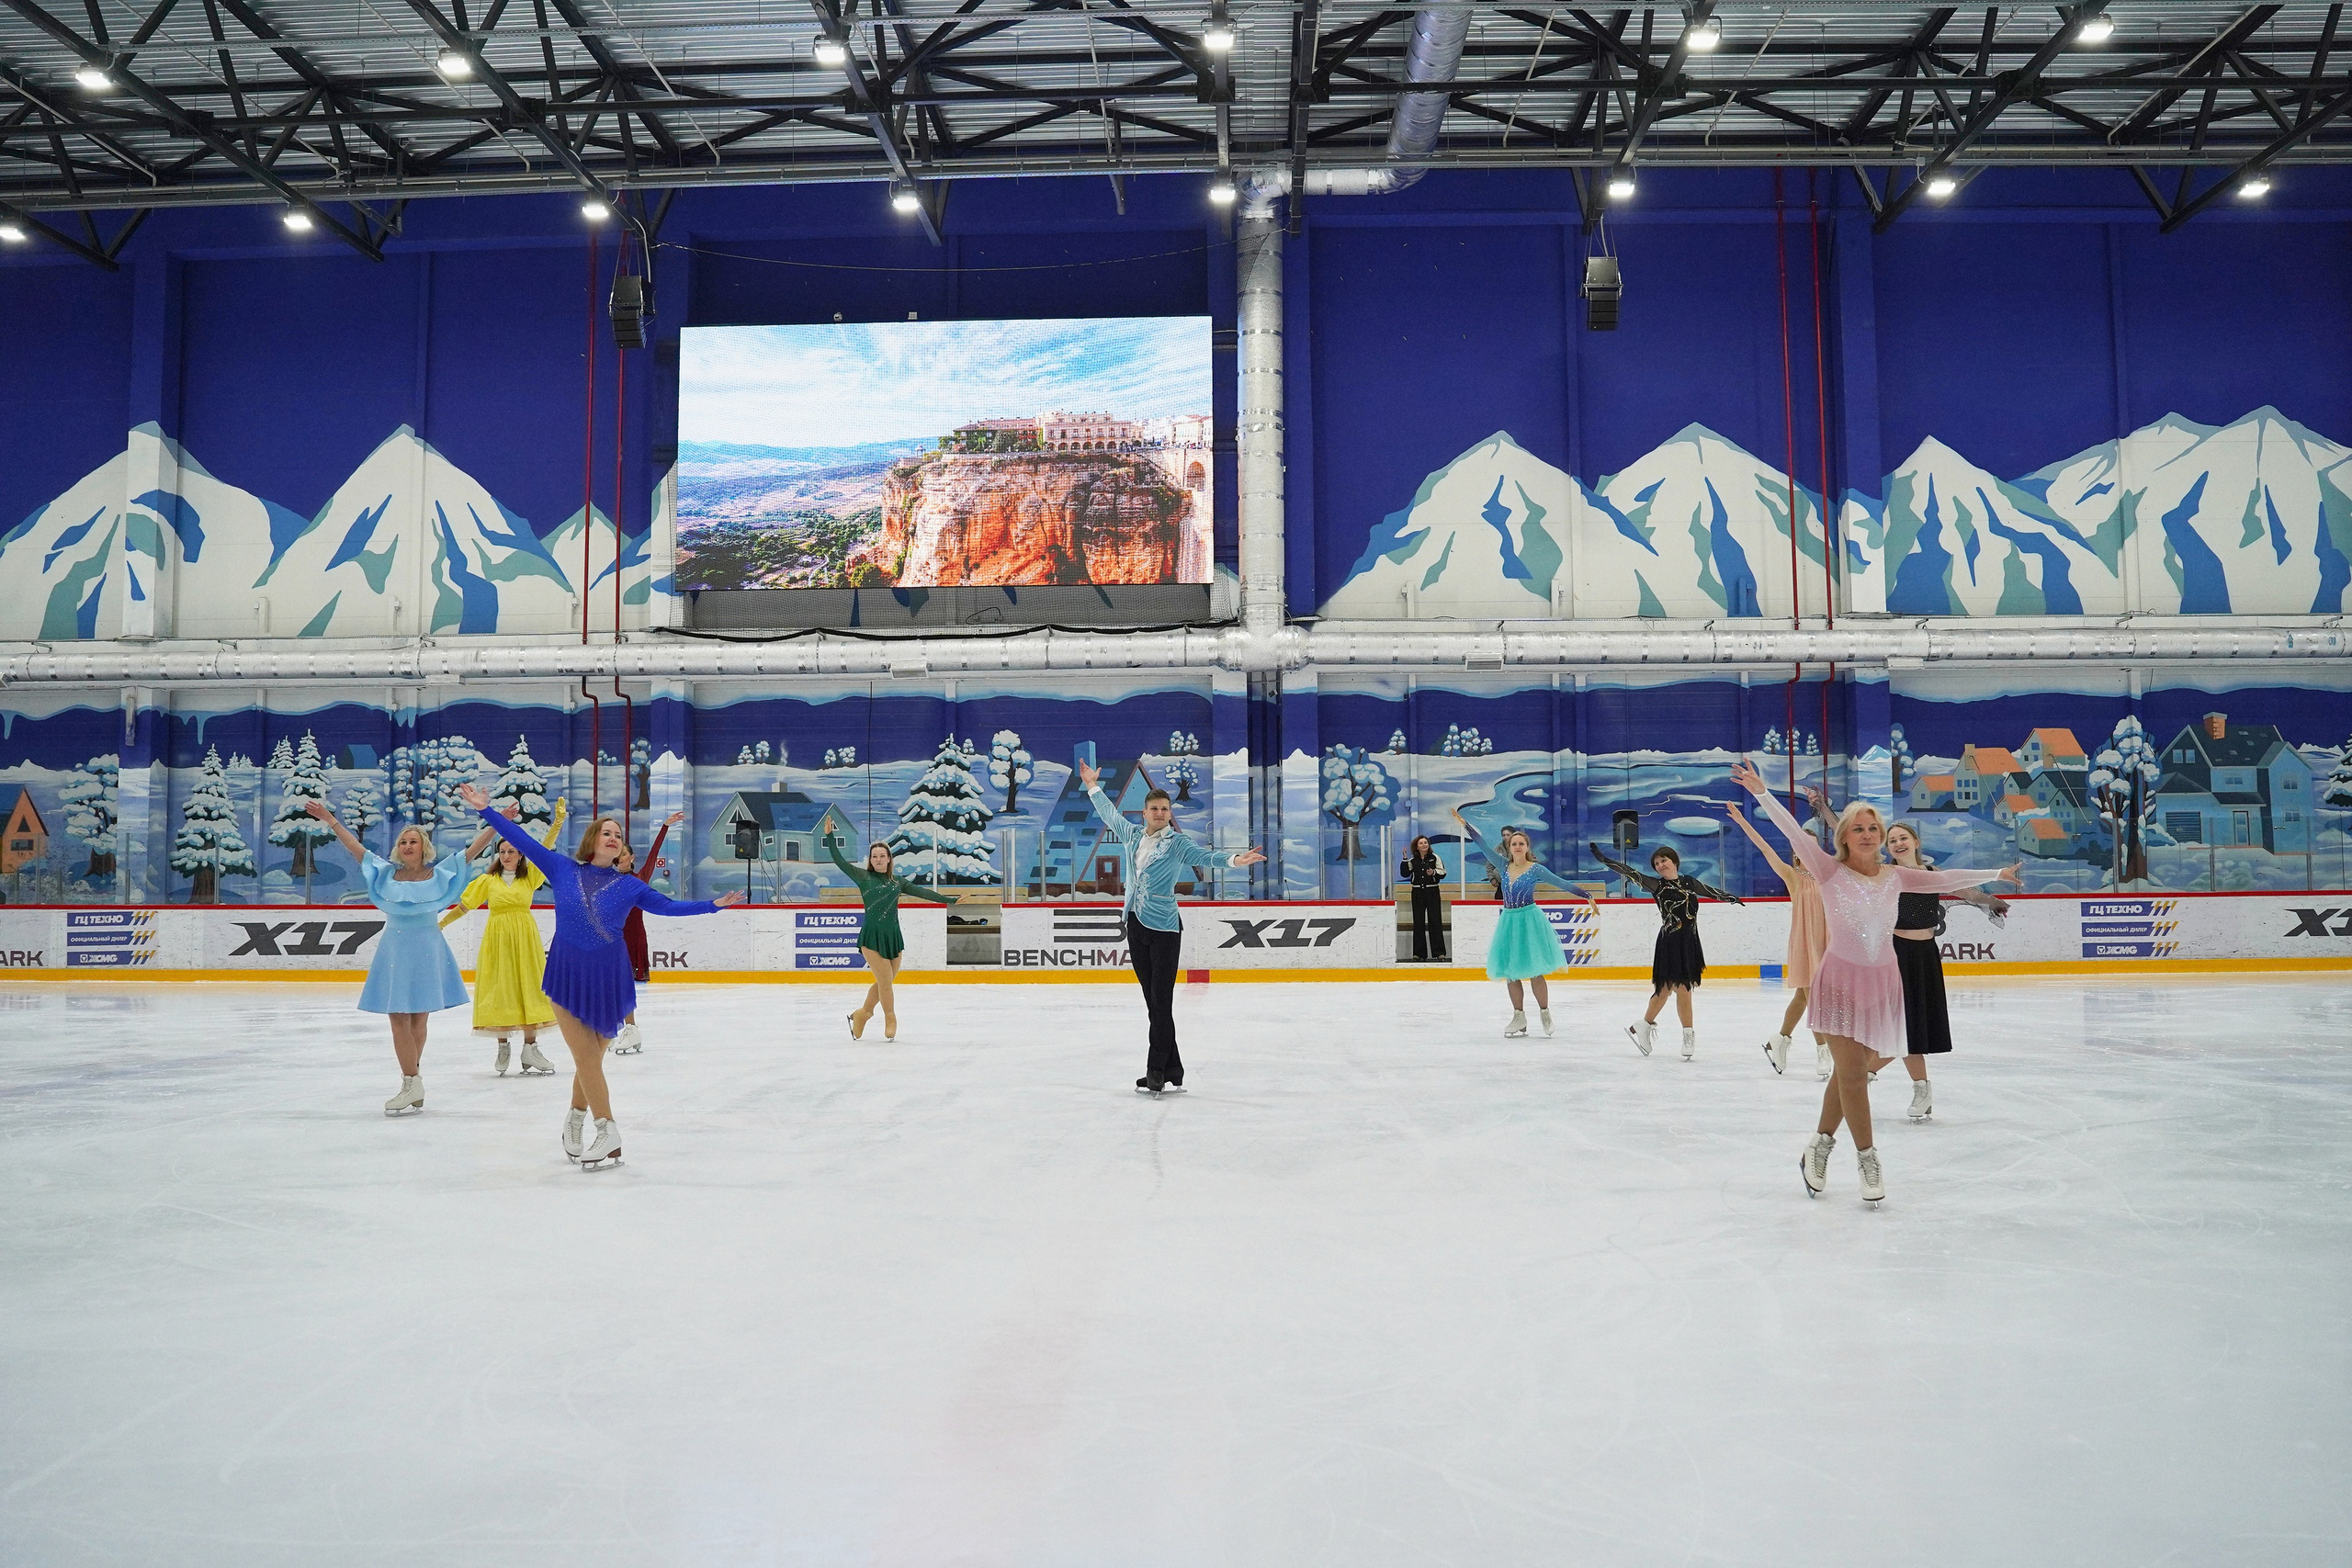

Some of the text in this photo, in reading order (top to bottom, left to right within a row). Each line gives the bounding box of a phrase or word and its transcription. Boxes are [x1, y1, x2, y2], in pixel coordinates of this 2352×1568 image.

[2089, 905, 2143, 915] ГЦ ТЕХНО
[74, 915, 124, 926] ГЦ ТЕХНО
[804, 916, 858, 926] ГЦ ТЕХНО
[229, 920, 386, 955] X17
[1217, 918, 1357, 948] X17
[2106, 945, 2138, 954] XCMG
[88, 954, 118, 963] XCMG
[819, 957, 851, 965] XCMG
